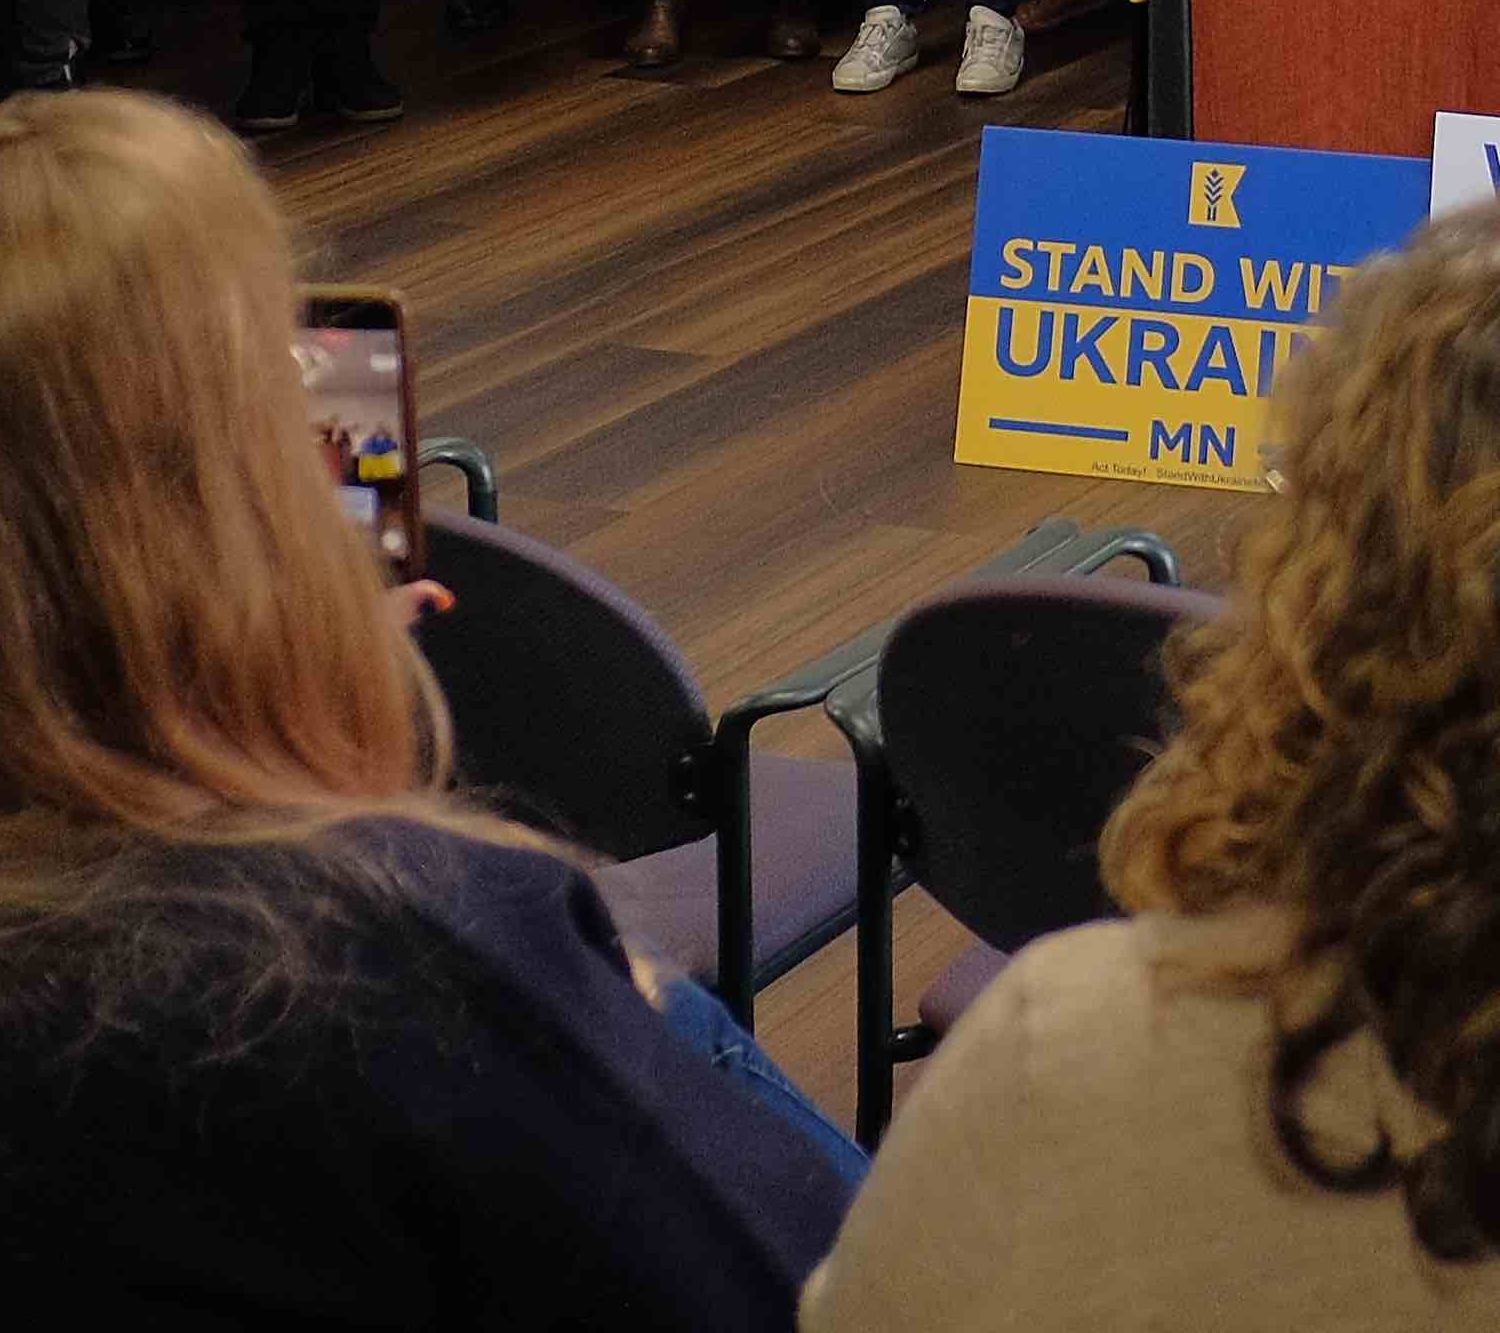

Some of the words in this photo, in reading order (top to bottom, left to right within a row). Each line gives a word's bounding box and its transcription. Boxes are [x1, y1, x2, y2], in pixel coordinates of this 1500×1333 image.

[1000, 238, 1216, 304] STAND
[1239, 256, 1355, 314] WI
[995, 307, 1300, 398] UKRAI
[1150, 419, 1237, 467] MN
